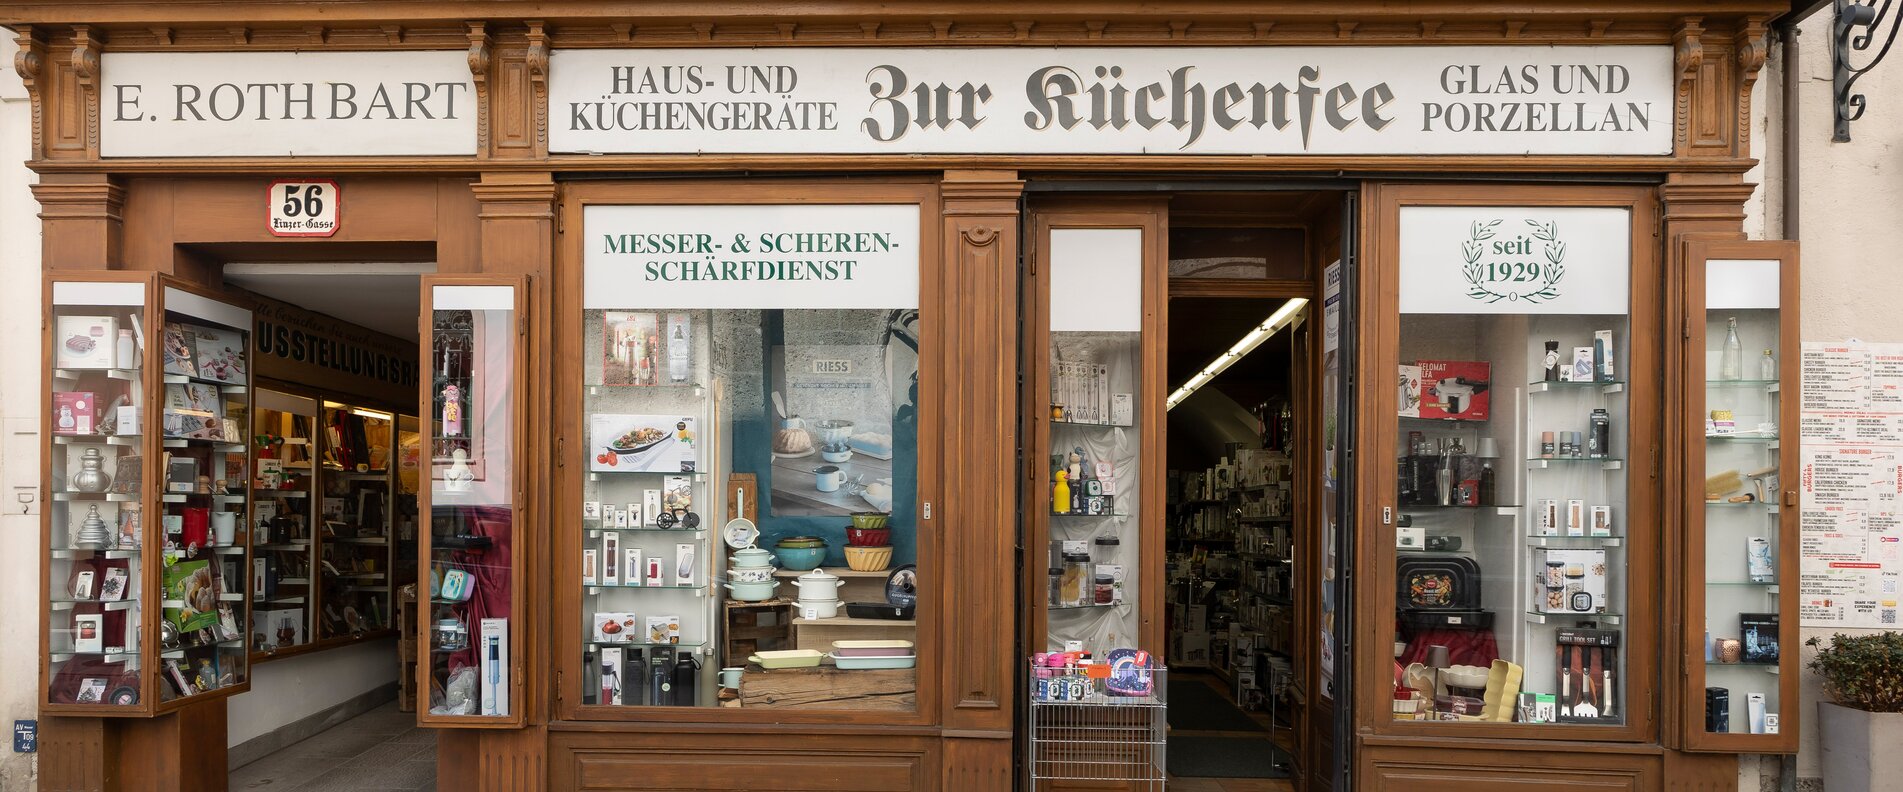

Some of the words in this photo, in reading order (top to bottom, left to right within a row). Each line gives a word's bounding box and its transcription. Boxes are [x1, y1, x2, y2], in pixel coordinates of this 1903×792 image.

[611, 65, 714, 94] HAUS-
[725, 65, 798, 94] UND
[1440, 64, 1539, 94] GLAS
[1551, 64, 1630, 94] UND
[112, 84, 157, 122] E.
[568, 95, 839, 131] KÜCHENGERÄTE
[861, 64, 994, 143] Zur
[1024, 64, 1397, 151] Küchenfee
[1421, 102, 1652, 132] PORZELLAN
[283, 185, 323, 217] 56
[273, 217, 334, 230] Linzer-Gasse
[603, 233, 723, 254] MESSER-
[731, 233, 752, 254] &
[760, 232, 900, 254] SCHEREN-
[1492, 235, 1533, 255] seit
[645, 255, 857, 281] SCHÄRFDIENST
[1486, 262, 1540, 282] 1929
[816, 361, 848, 372] RIESS
